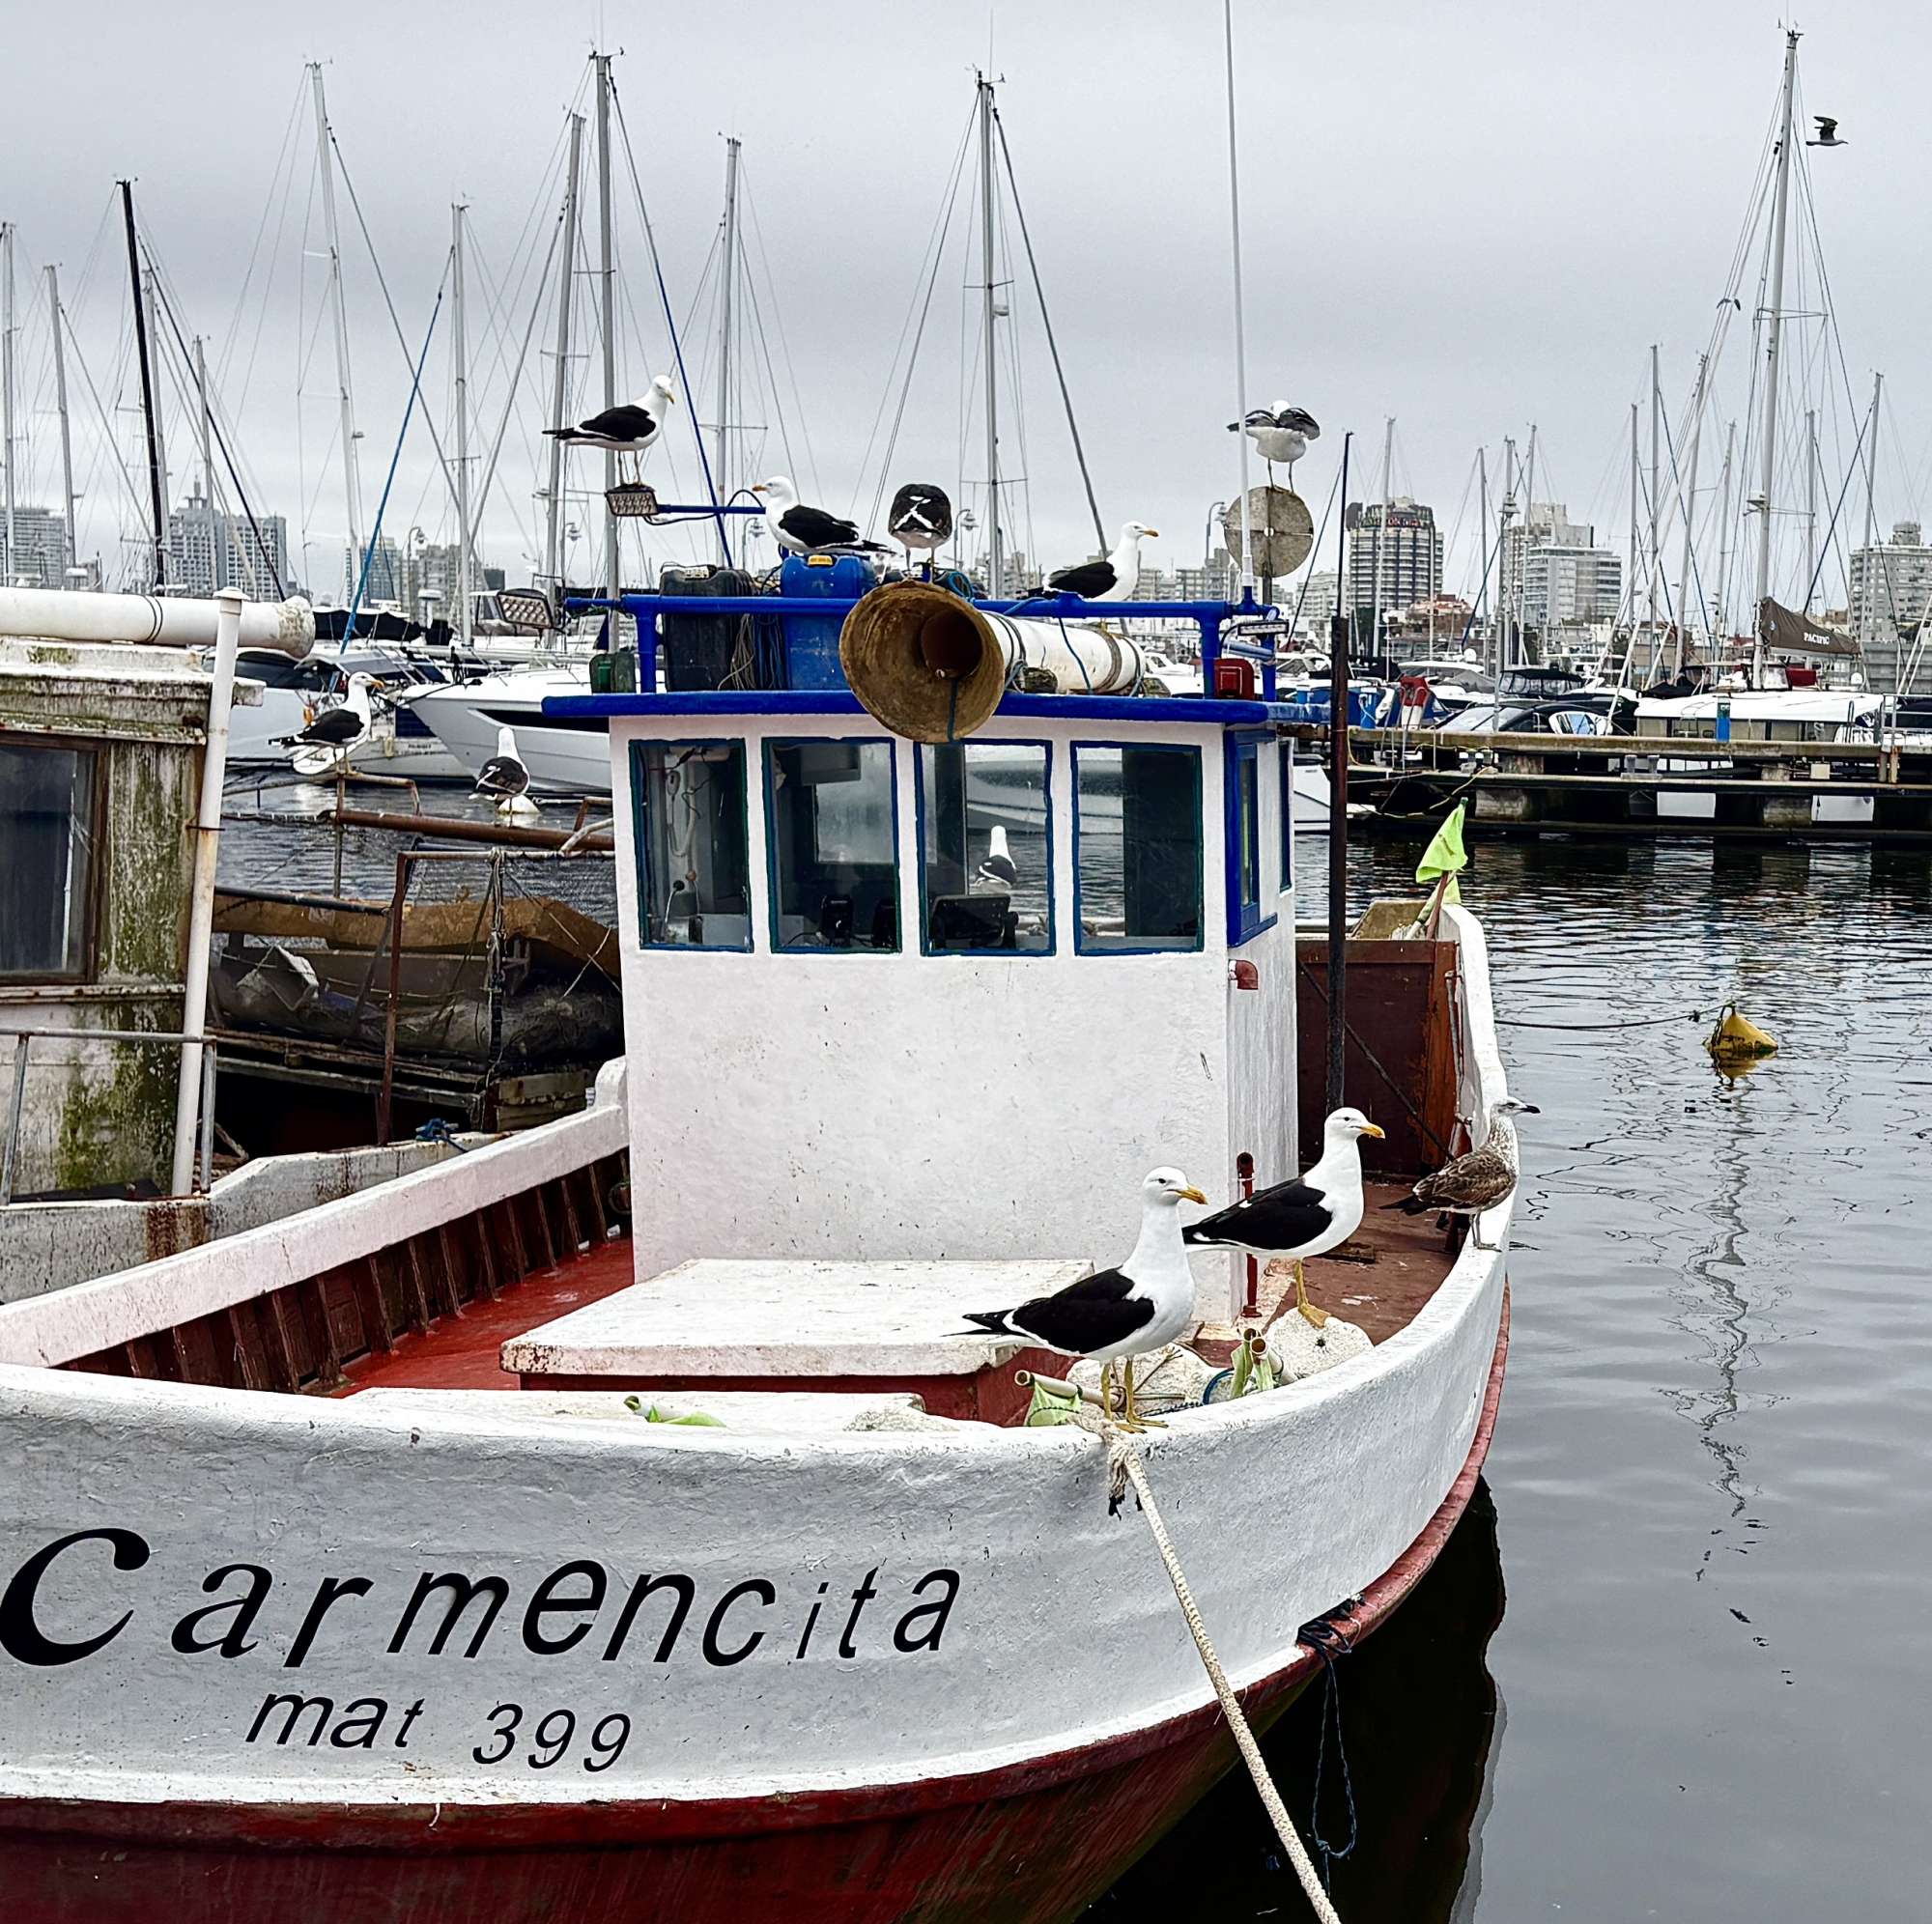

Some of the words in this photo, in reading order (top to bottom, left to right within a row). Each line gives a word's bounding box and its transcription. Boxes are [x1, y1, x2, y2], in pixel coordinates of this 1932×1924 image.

[0, 1527, 961, 1668] Carmencita
[245, 1693, 425, 1749] mat
[472, 1703, 631, 1772] 399
